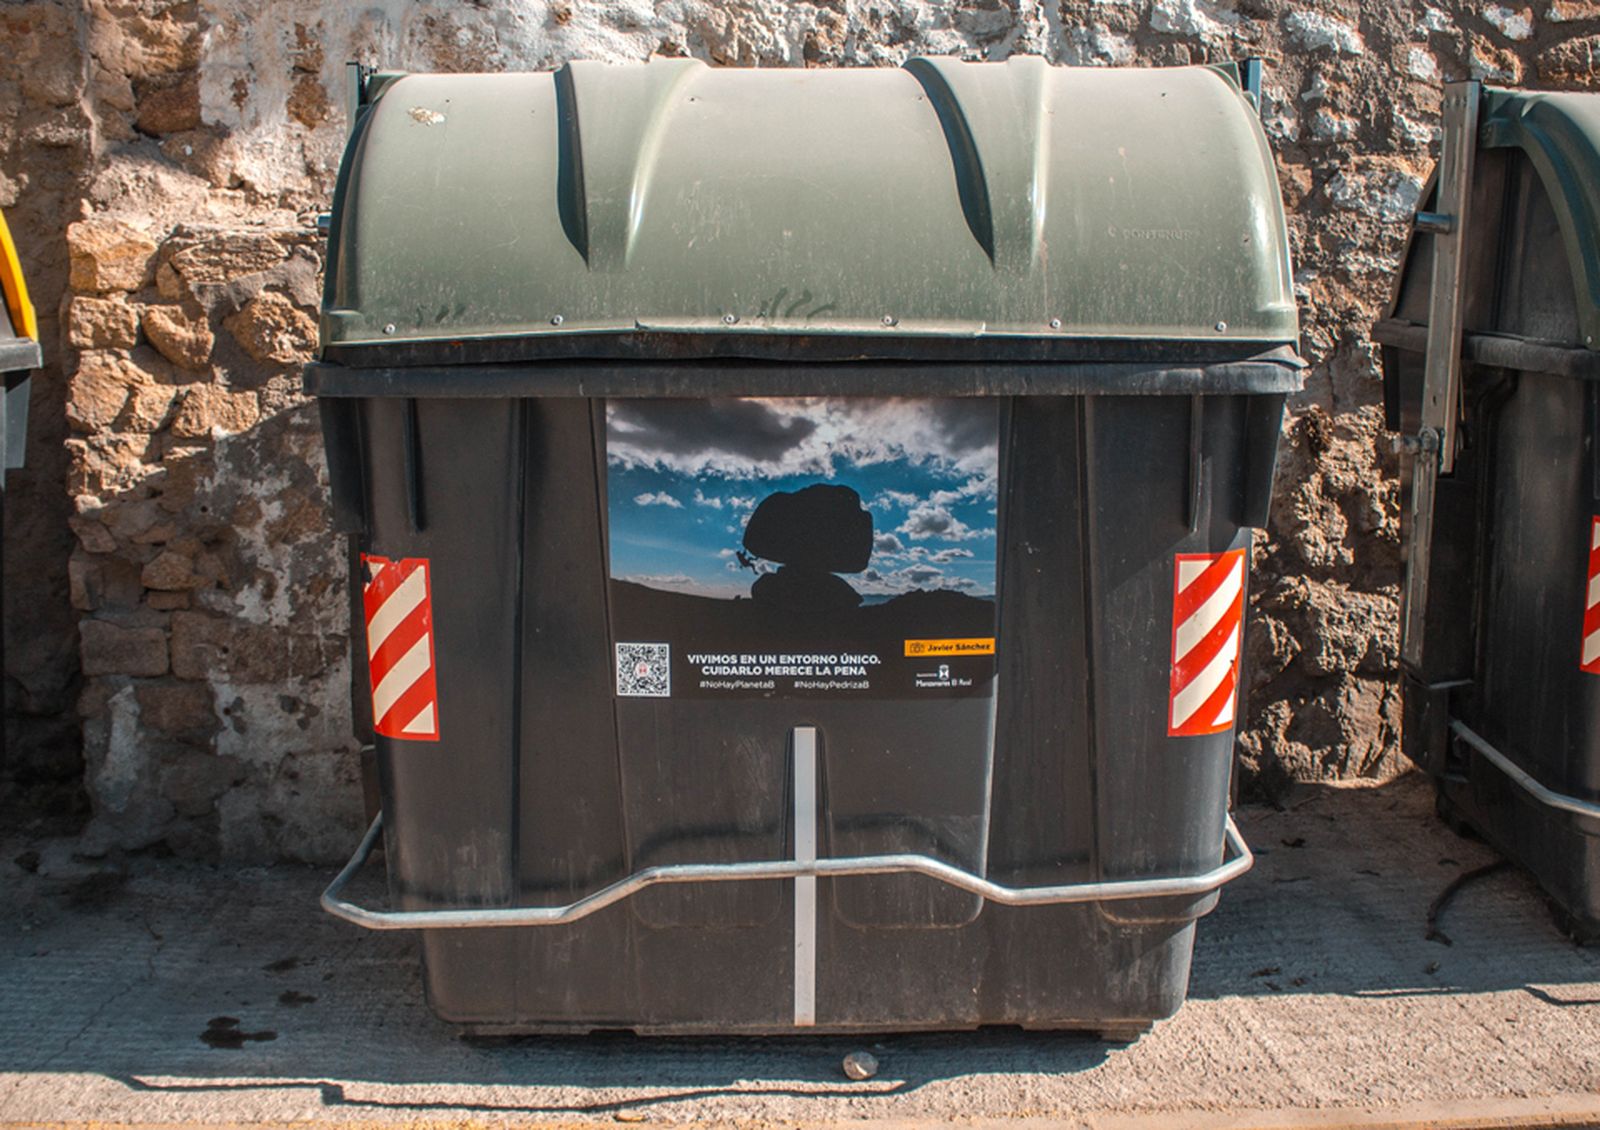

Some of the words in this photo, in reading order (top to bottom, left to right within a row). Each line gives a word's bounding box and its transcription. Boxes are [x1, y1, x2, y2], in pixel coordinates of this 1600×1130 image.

[927, 644, 954, 652] Javier
[955, 642, 991, 651] Sánchez
[687, 654, 738, 664] VIVIMOS
[740, 654, 757, 664] EN
[759, 654, 777, 664] UN
[779, 654, 838, 664] ENTORNO
[840, 652, 881, 664] ÚNICO.
[701, 665, 763, 676] CUIDARLO
[764, 665, 813, 676] MERECE
[815, 665, 832, 676] LA
[834, 665, 868, 676] PENA
[699, 680, 776, 690] #NoHayPlanetaB
[793, 680, 870, 690] #NoHayPedrizaB
